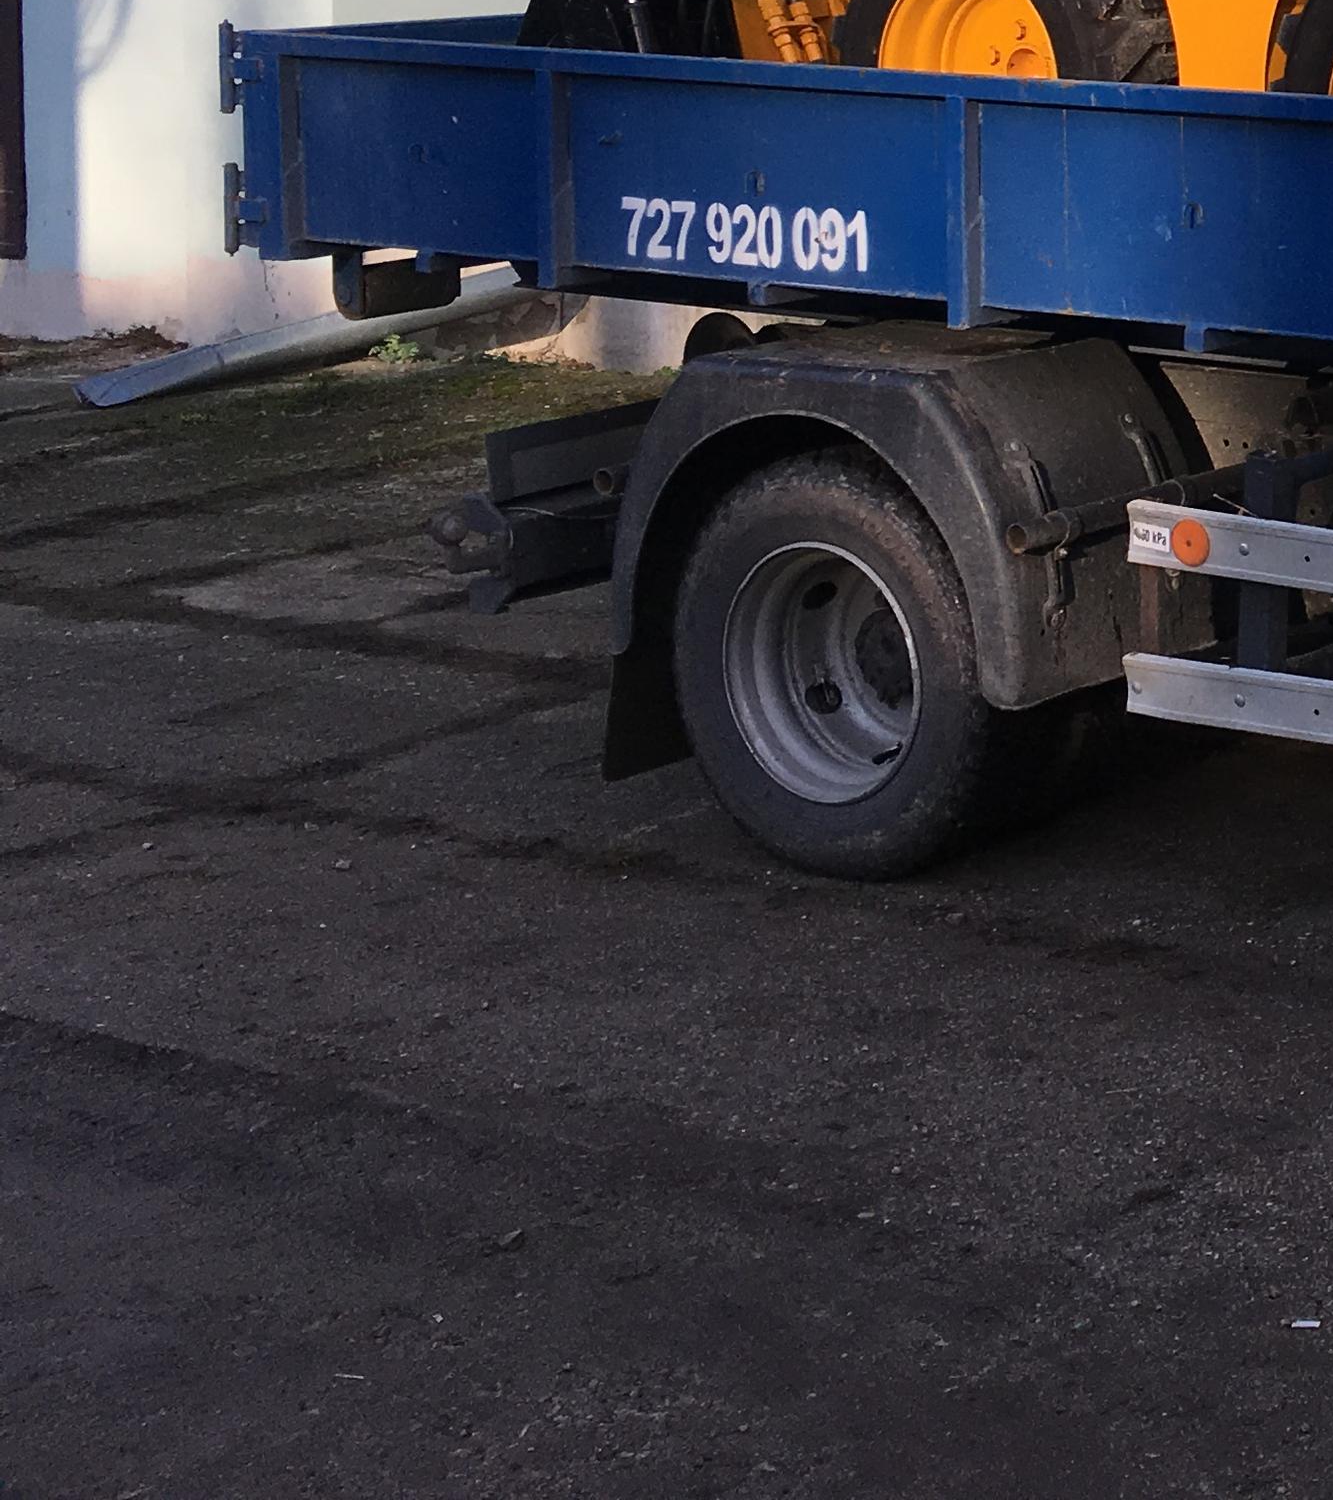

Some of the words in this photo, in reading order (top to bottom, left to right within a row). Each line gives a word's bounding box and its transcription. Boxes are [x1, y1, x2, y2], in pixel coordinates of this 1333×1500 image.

[620, 196, 696, 261] 727
[705, 202, 783, 269] 920
[791, 206, 868, 272] 091
[1152, 531, 1167, 547] kPa
